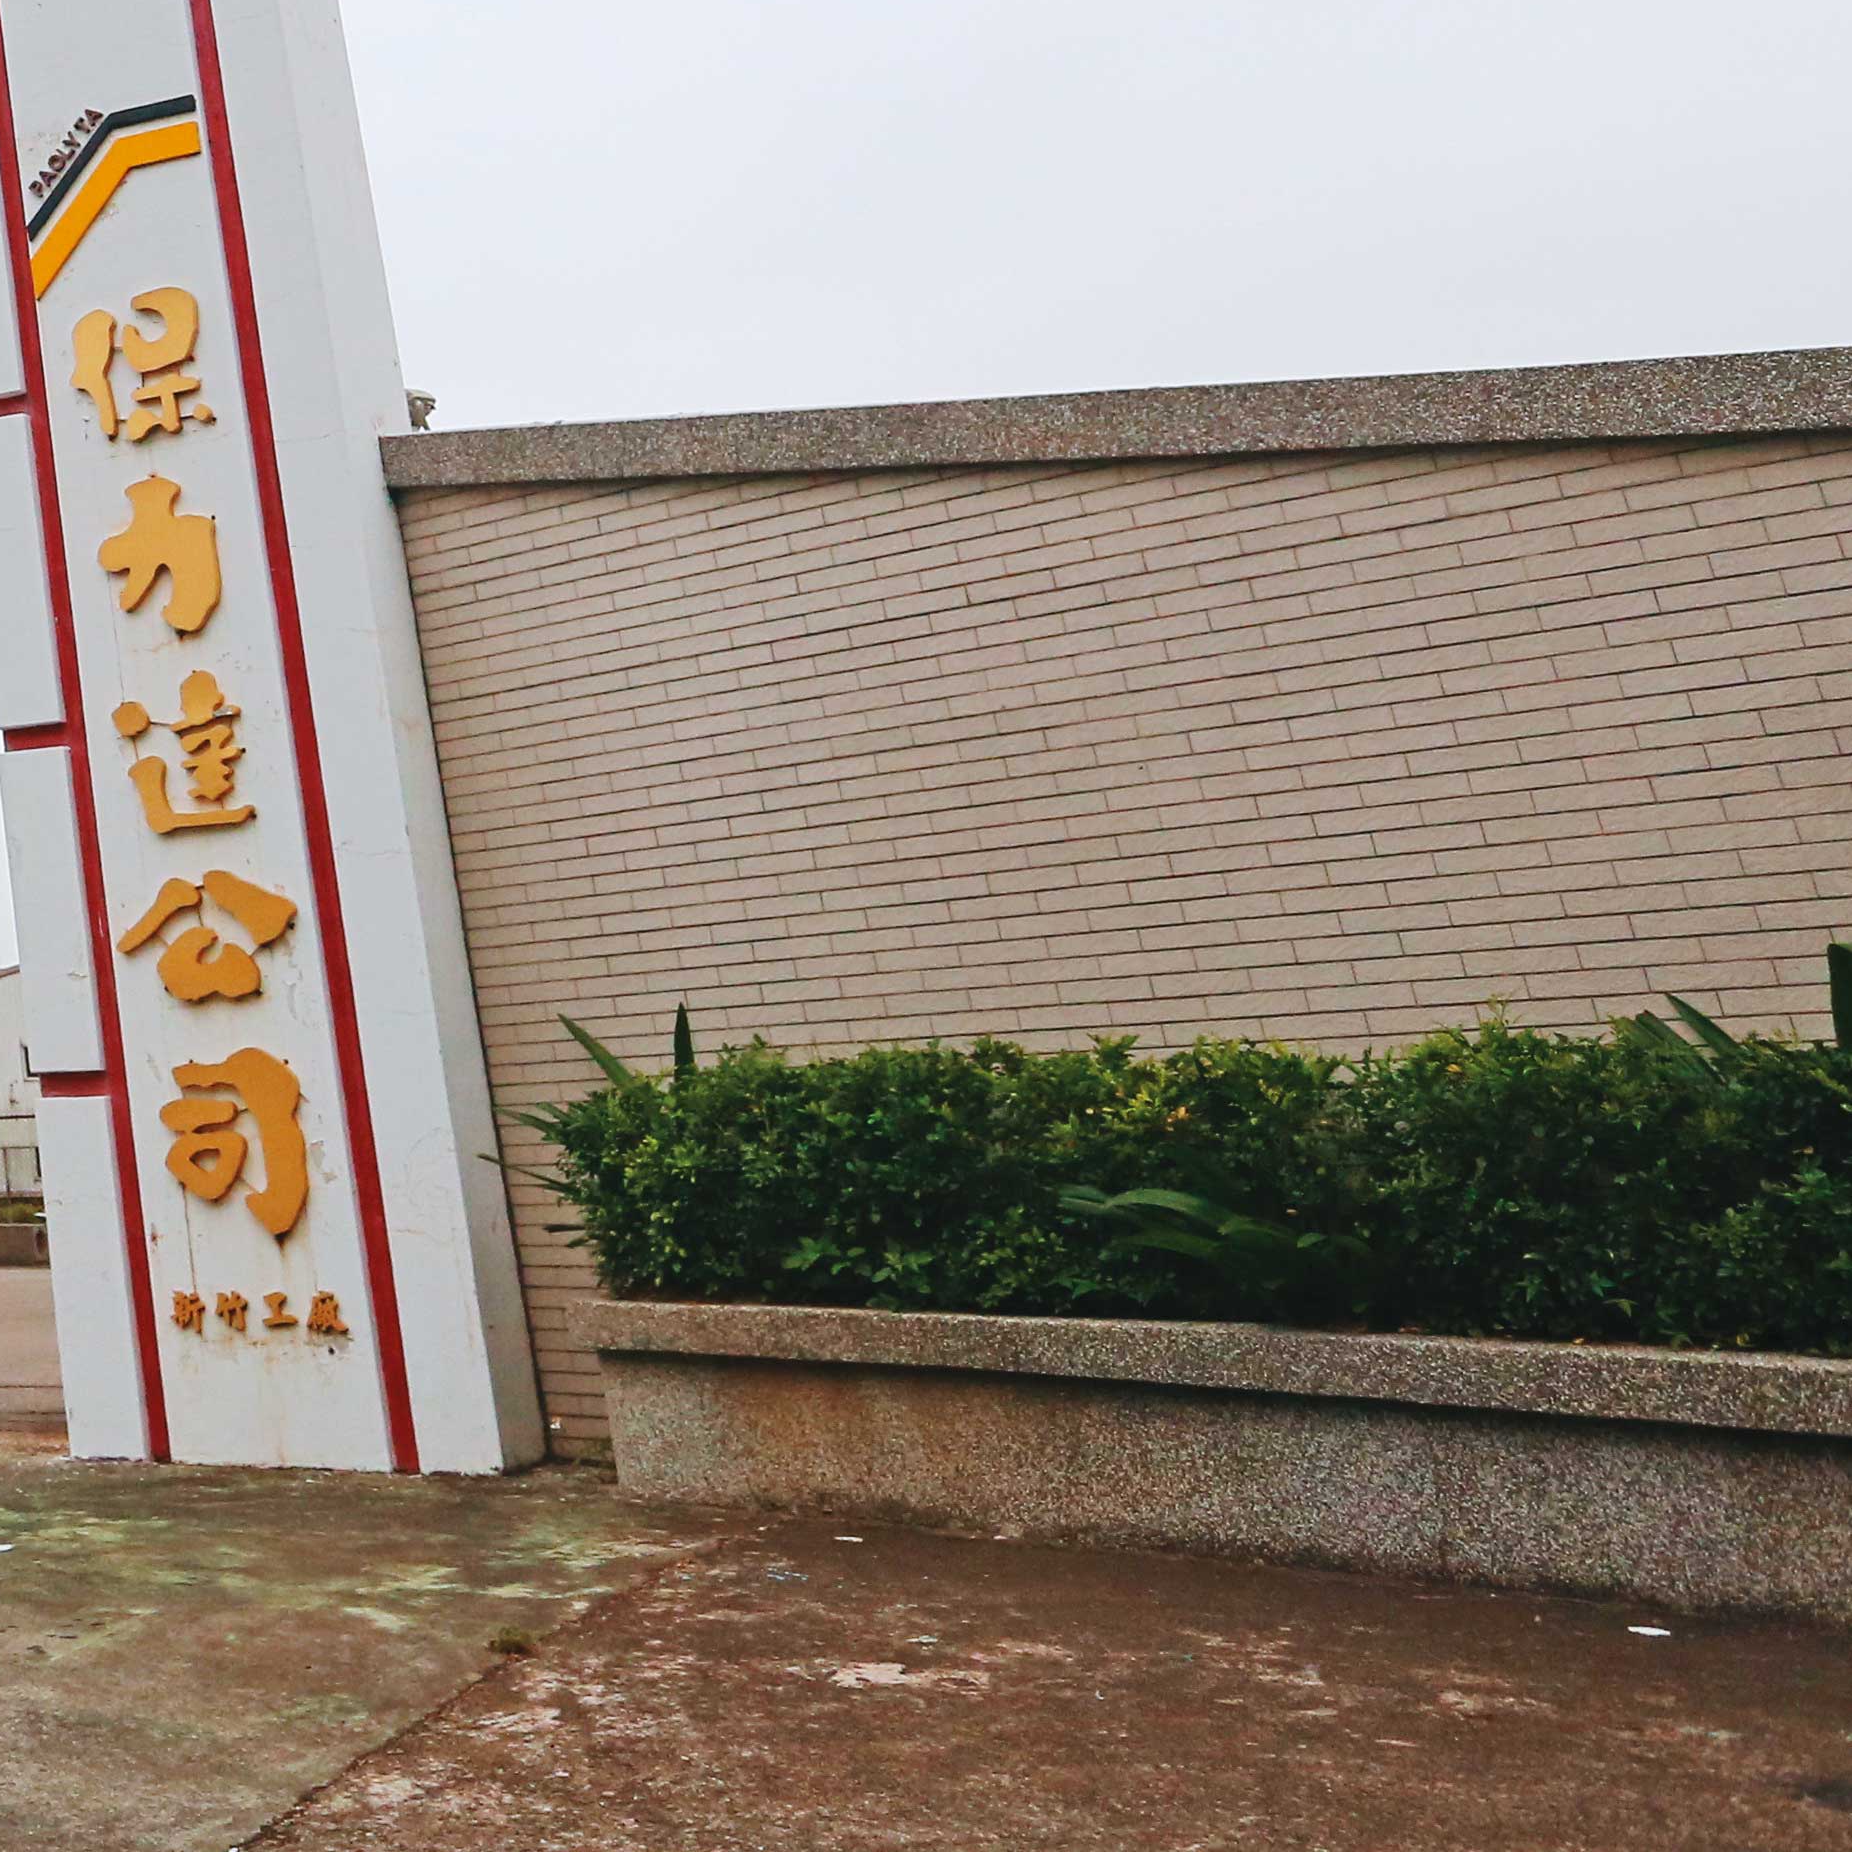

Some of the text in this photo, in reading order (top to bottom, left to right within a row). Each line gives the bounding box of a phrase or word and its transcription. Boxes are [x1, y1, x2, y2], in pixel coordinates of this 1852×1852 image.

[28, 109, 104, 198] PAOLYTA
[70, 286, 309, 1238] 保力達公司
[170, 1290, 349, 1334] 新竹工廠
